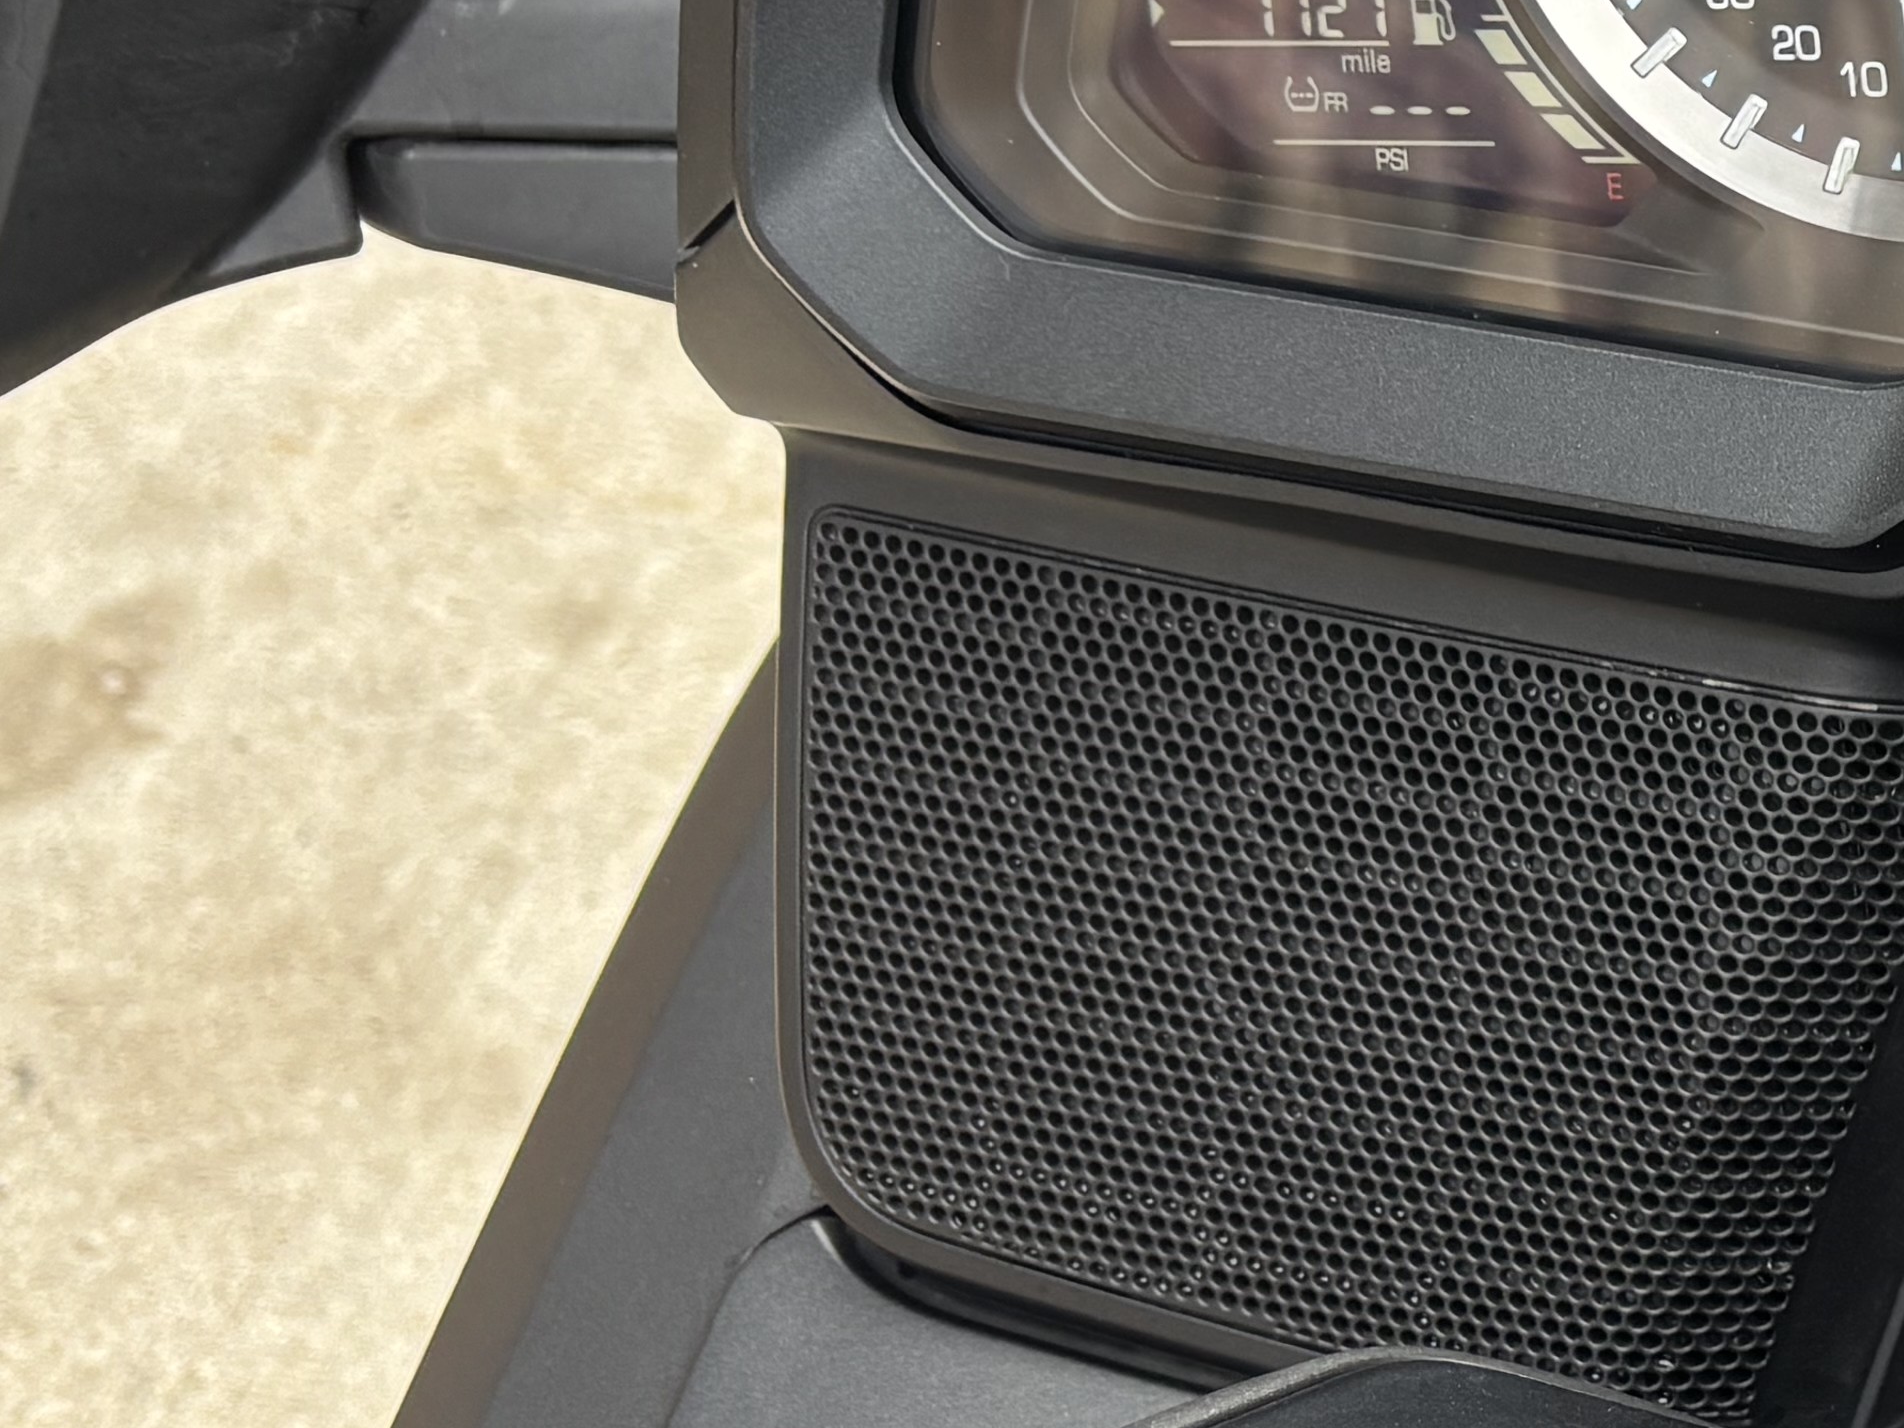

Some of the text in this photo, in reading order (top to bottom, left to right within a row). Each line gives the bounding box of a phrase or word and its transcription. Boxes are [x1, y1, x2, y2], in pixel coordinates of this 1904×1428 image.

[1772, 25, 1821, 61] 20
[1341, 51, 1391, 73] mile
[1840, 61, 1887, 97] 10
[1376, 150, 1408, 171] PSI
[1607, 173, 1624, 200] E
